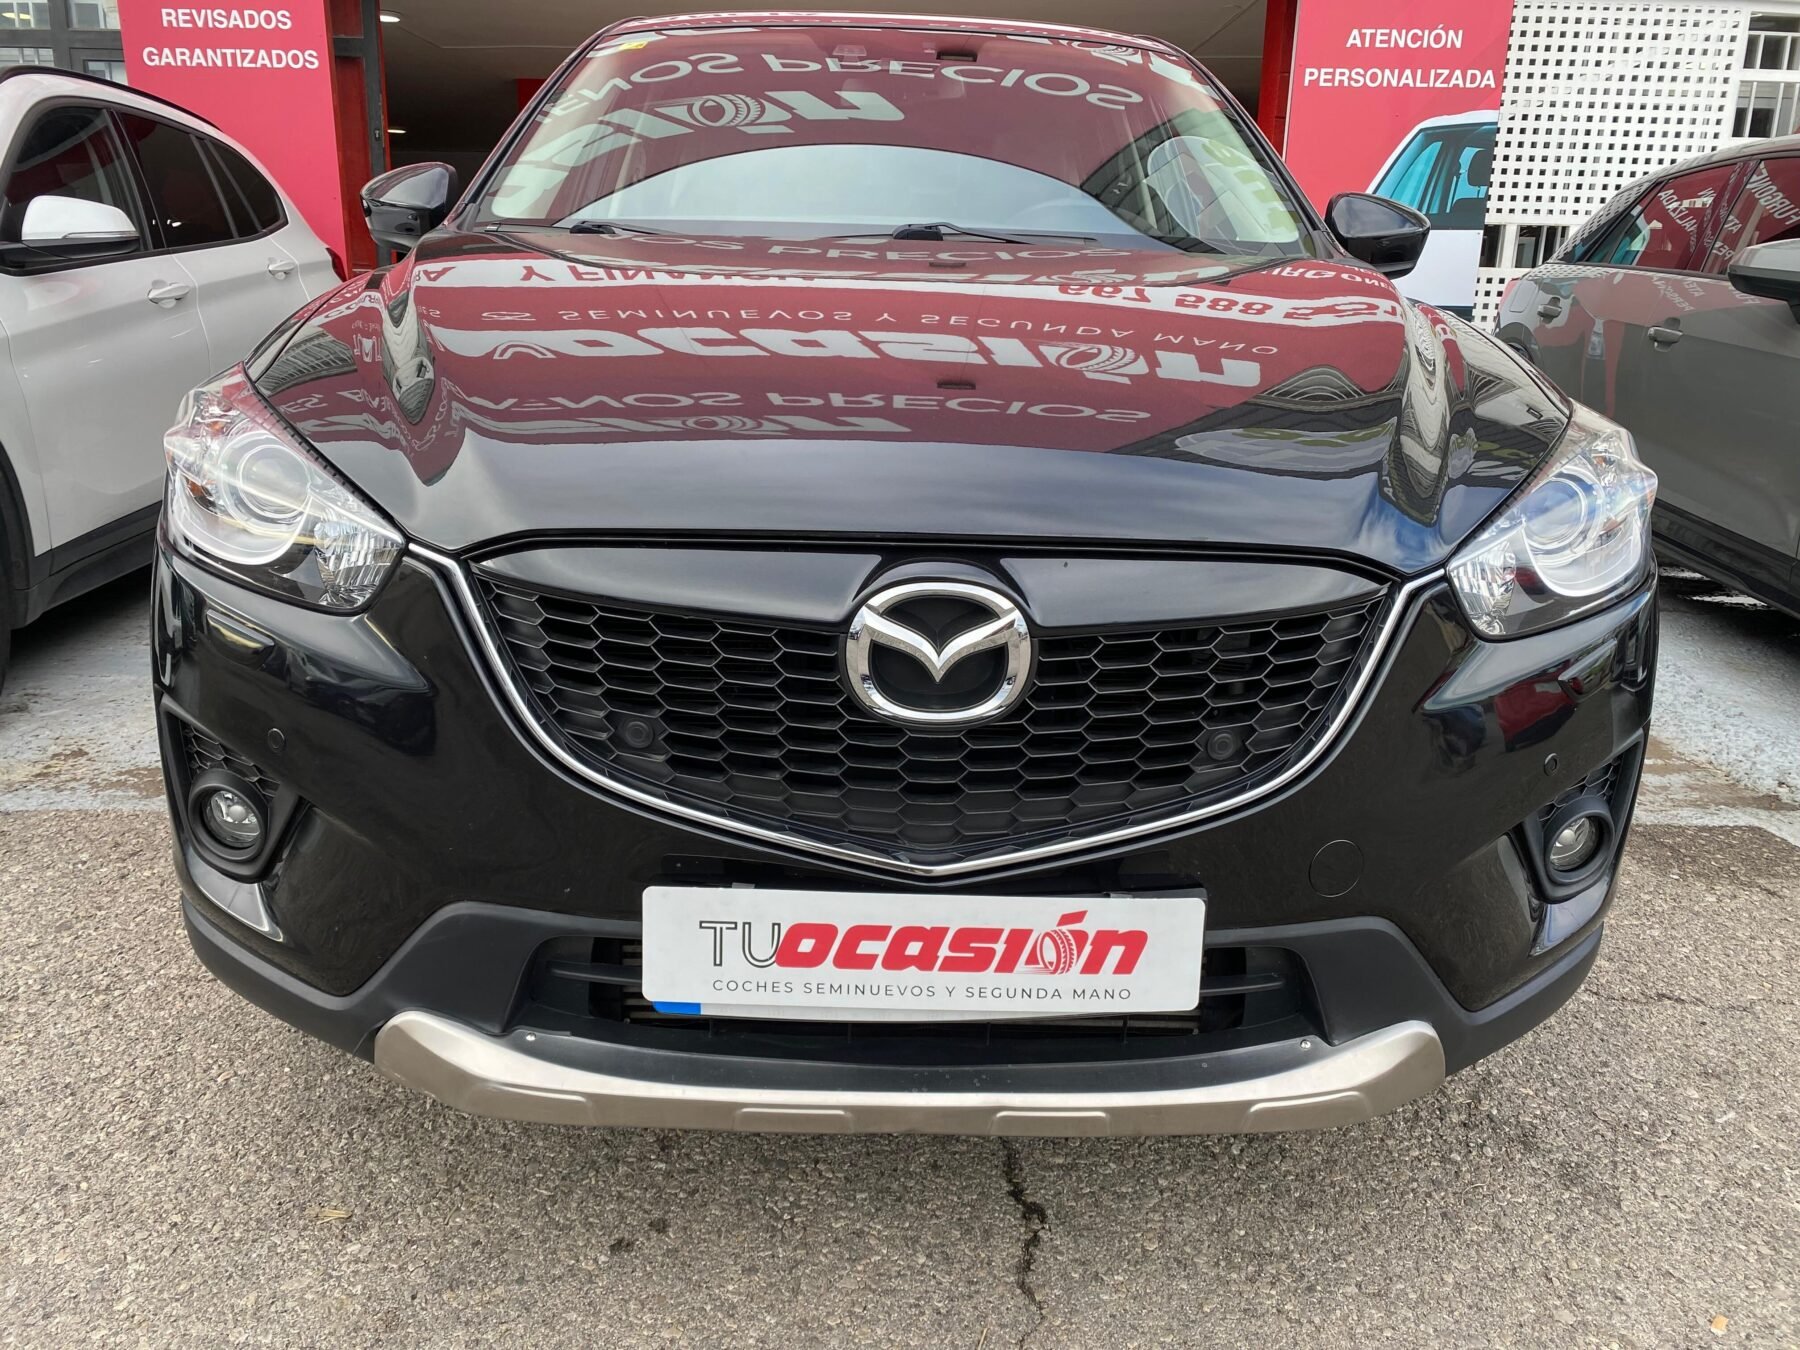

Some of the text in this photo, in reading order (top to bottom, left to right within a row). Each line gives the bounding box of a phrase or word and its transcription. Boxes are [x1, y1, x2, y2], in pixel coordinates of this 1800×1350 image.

[161, 8, 292, 30] REVISADOS
[1346, 24, 1463, 48] ATENCIÓN
[142, 46, 319, 69] GARANTIZADOS
[1303, 67, 1496, 88] PERSONALIZADA
[712, 979, 1132, 1001] COCHES SEMINUEVOS Y SEGUNDA MANO
